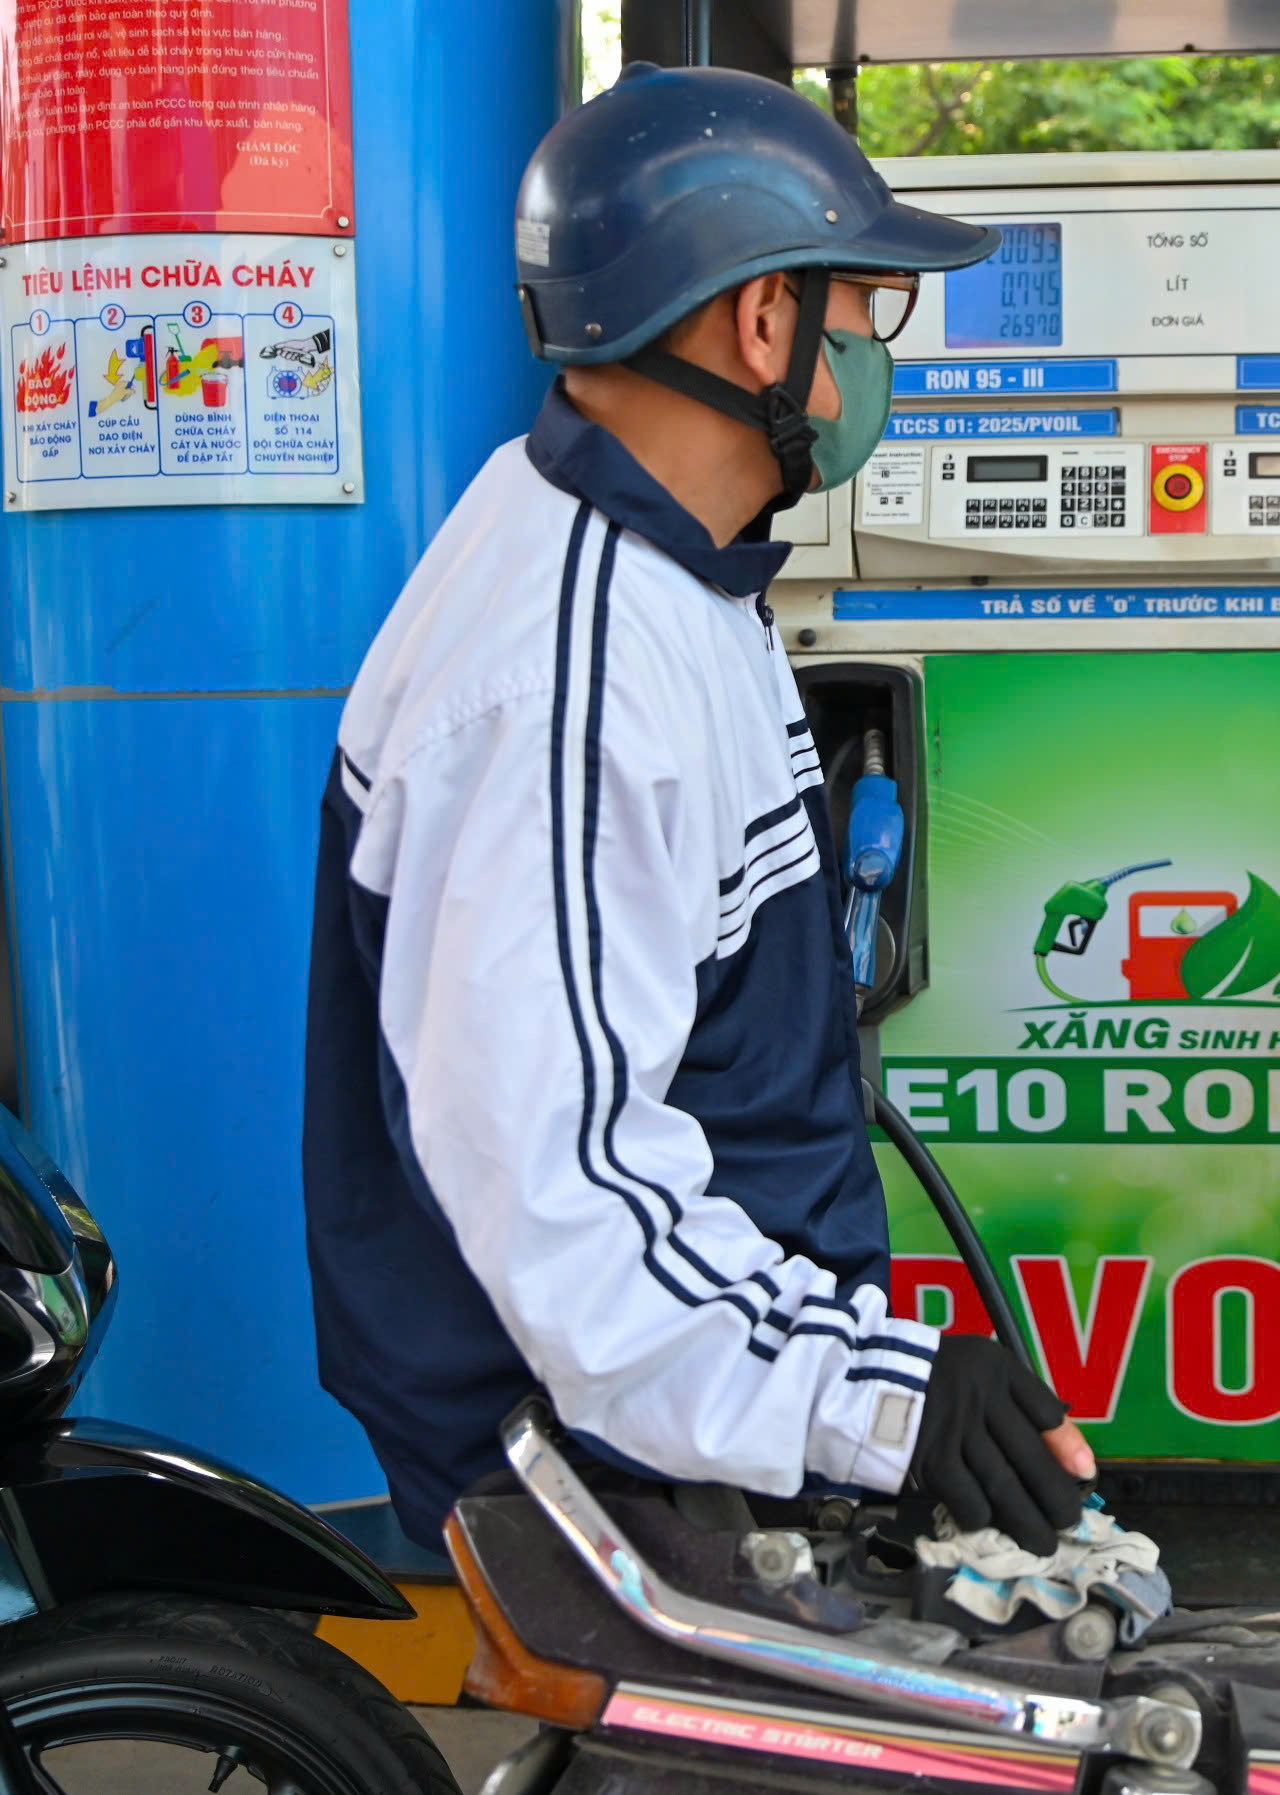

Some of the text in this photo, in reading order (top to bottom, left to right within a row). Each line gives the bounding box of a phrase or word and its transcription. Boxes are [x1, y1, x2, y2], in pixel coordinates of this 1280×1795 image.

[155, 99, 185, 109] PCCC
[96, 119, 124, 129] PCCC
[1147, 231, 1209, 248] TỔNG SỐ
[22, 258, 315, 298] TIÊU LỆNH CHỮA CHÁY
[1166, 277, 1189, 292] LÍT
[107, 308, 118, 326] 2
[191, 305, 203, 324] 3
[281, 306, 295, 324] 4
[1151, 313, 1205, 327] ĐƠN GIÁ
[1000, 314, 1060, 338] 26970
[926, 369, 970, 391] RON
[976, 368, 1003, 390] 95
[1023, 367, 1045, 388] III
[175, 411, 232, 423] DÙNG BÌNH
[893, 415, 1082, 434] TCCS 01: 2025/PVOIL
[100, 433, 119, 441] DAO
[175, 424, 236, 436] CHỮA CHÁY
[275, 426, 288, 436] SỐ
[128, 443, 156, 454] CHÁY
[171, 439, 191, 450] CÁT
[306, 438, 334, 449] CHÁY
[982, 595, 1024, 615] TRẢ
[1031, 594, 1062, 614] SỐ
[1068, 594, 1096, 614] VỀ
[1144, 594, 1219, 613] TRƯỚC
[1225, 597, 1264, 612] KHI
[1017, 1011, 1171, 1050] XĂNG
[1178, 1029, 1258, 1051] SINH
[886, 1068, 1067, 1134] E10
[632, 1707, 884, 1760] ELECTRIC STARTER
